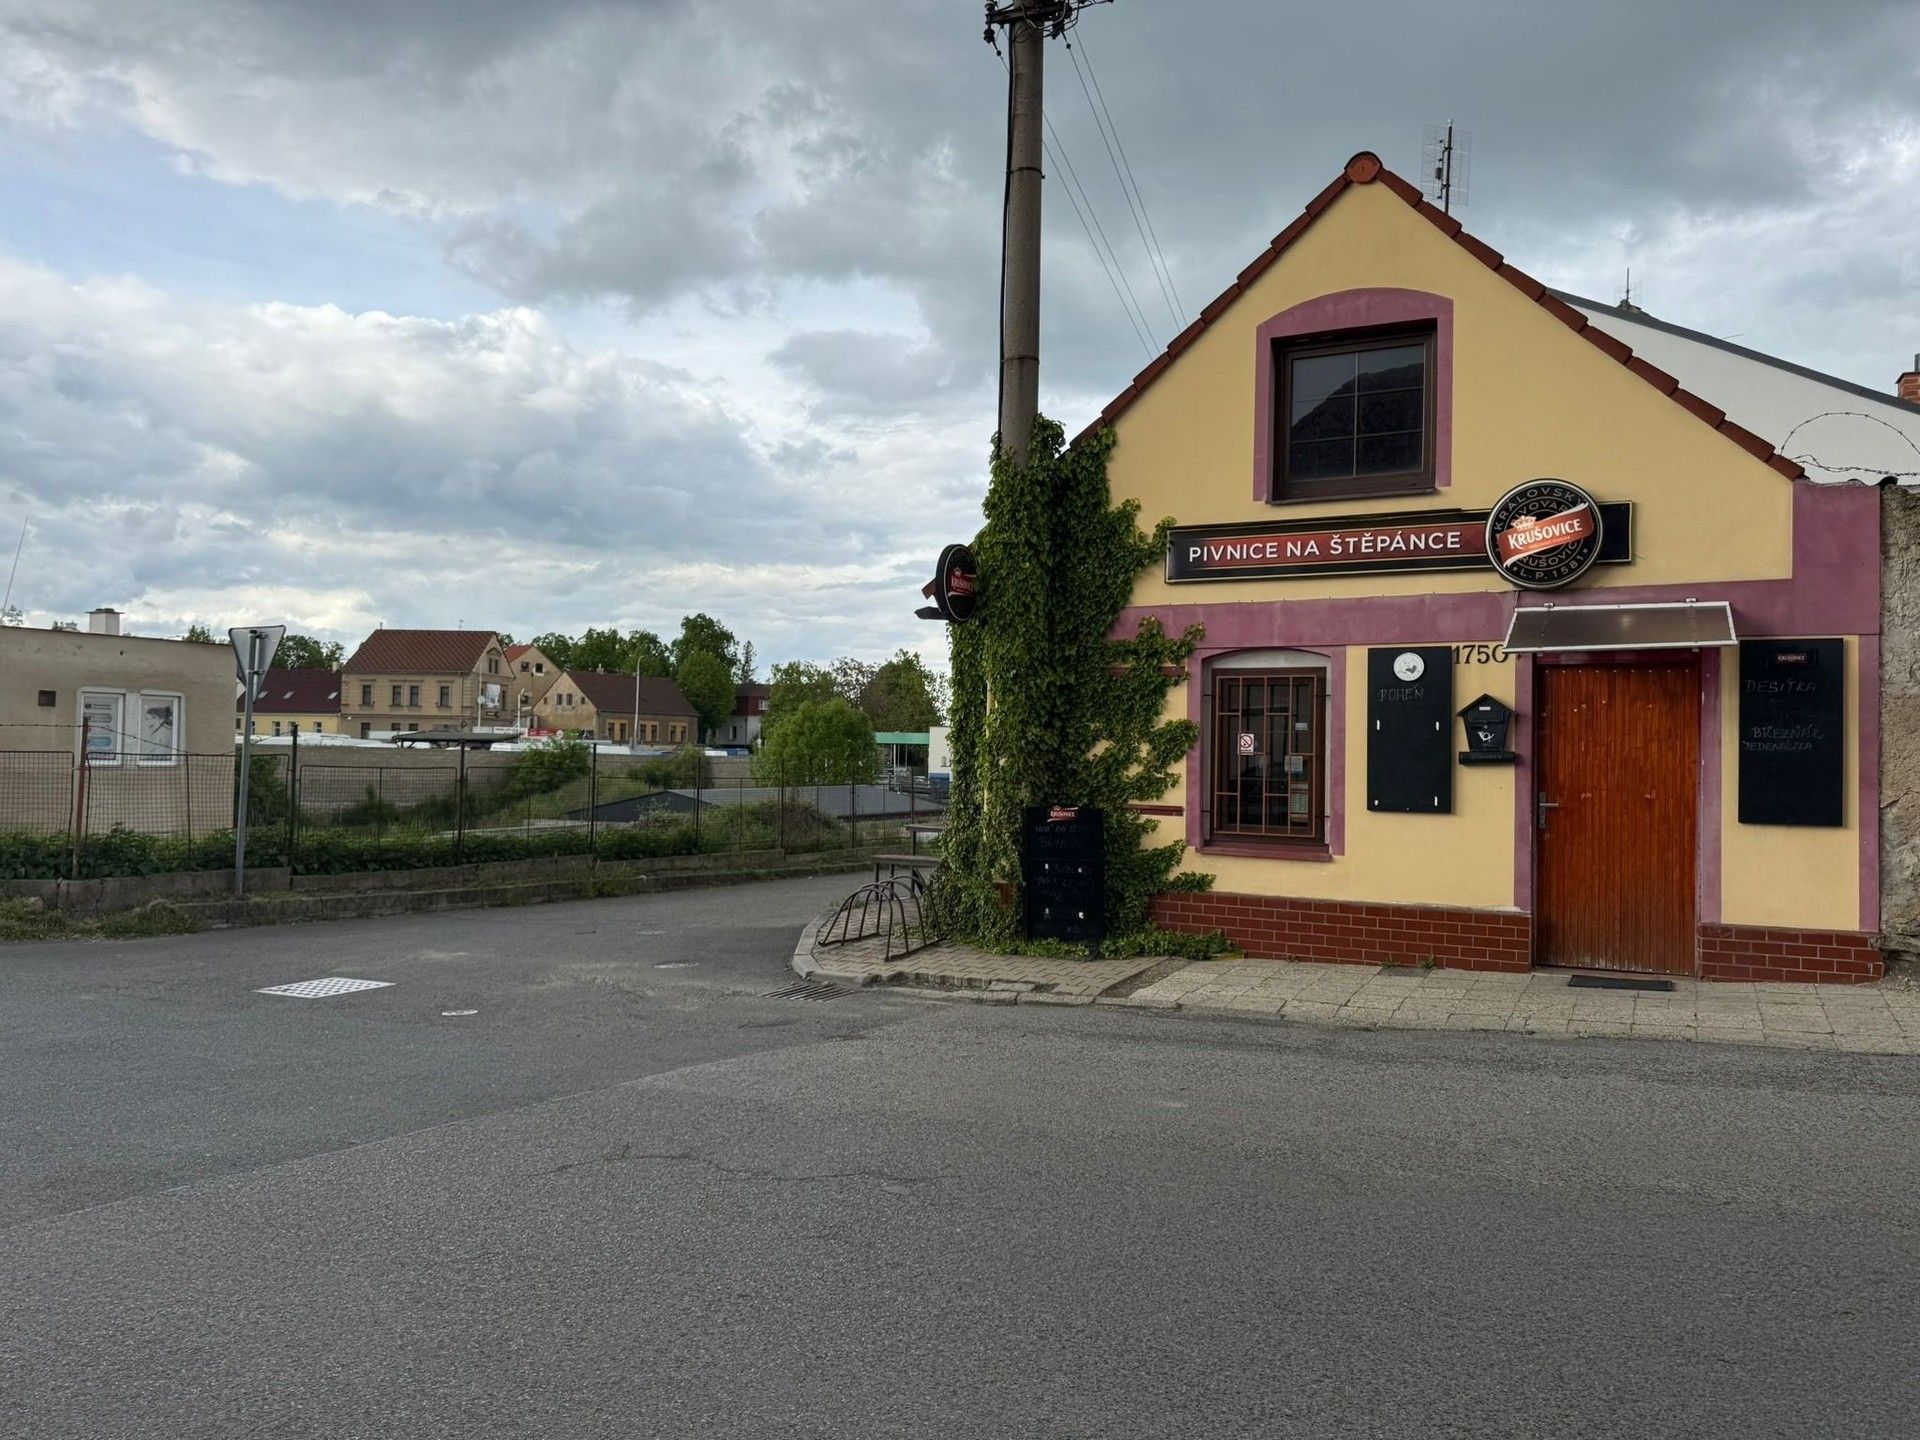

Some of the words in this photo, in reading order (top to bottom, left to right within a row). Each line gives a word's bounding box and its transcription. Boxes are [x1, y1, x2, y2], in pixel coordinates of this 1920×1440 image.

[1509, 500, 1569, 523] IVOVAR
[1188, 541, 1279, 562] PIVNICE
[1286, 540, 1320, 558] NA
[1329, 530, 1462, 555] ŠTĚPÁNCE
[1507, 518, 1583, 550] KRUŠOVICE
[1552, 554, 1585, 578] 1581
[1453, 644, 1510, 665] 1750
